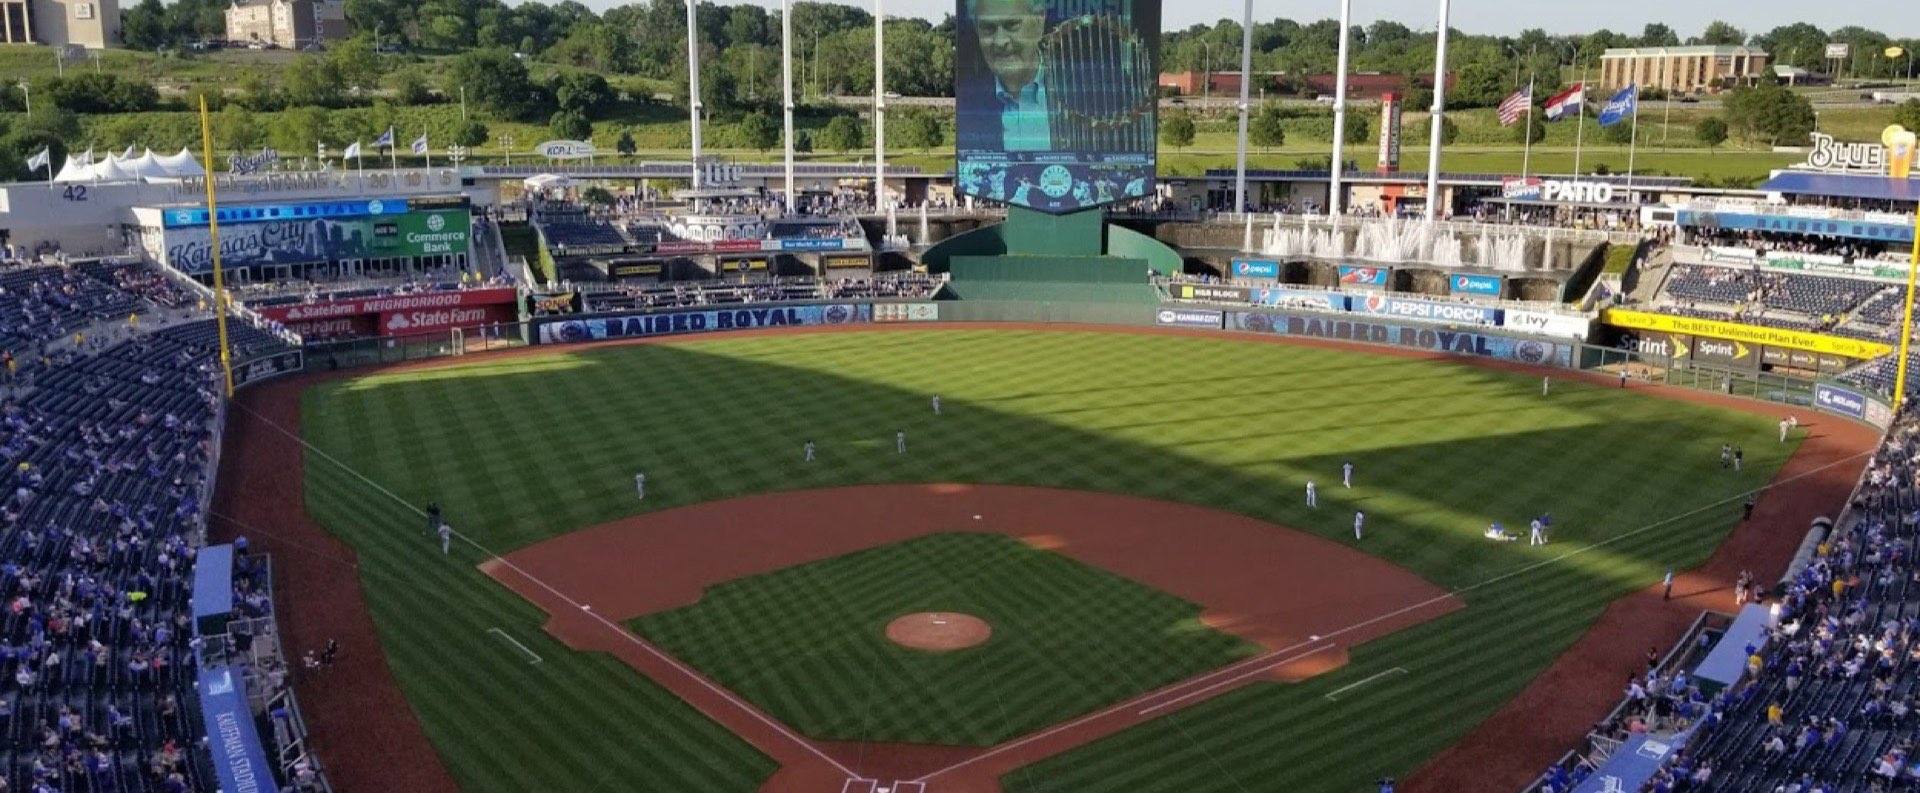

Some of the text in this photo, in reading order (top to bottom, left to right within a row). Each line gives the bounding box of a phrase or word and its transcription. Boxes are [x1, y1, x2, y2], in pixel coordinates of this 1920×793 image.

[228, 146, 278, 175] Royals
[1808, 132, 1881, 168] BLUE
[63, 184, 88, 201] 42
[1545, 180, 1612, 202] PATIO
[261, 220, 306, 250] City
[407, 231, 465, 243] Commerce
[424, 242, 451, 252] Bank
[363, 294, 462, 312] NEIGHBORHOOD
[1391, 300, 1484, 320] PEPSI PORCH
[606, 307, 802, 337] RAISED ROYAL
[1671, 320, 1690, 330] The
[1692, 322, 1716, 333] BEST
[1718, 325, 1767, 340] Unlimited
[1768, 332, 1790, 343] Plan
[1288, 316, 1491, 356] RAISED ROYAL
[1618, 334, 1668, 357] Sprint
[1700, 340, 1733, 356] Sprint
